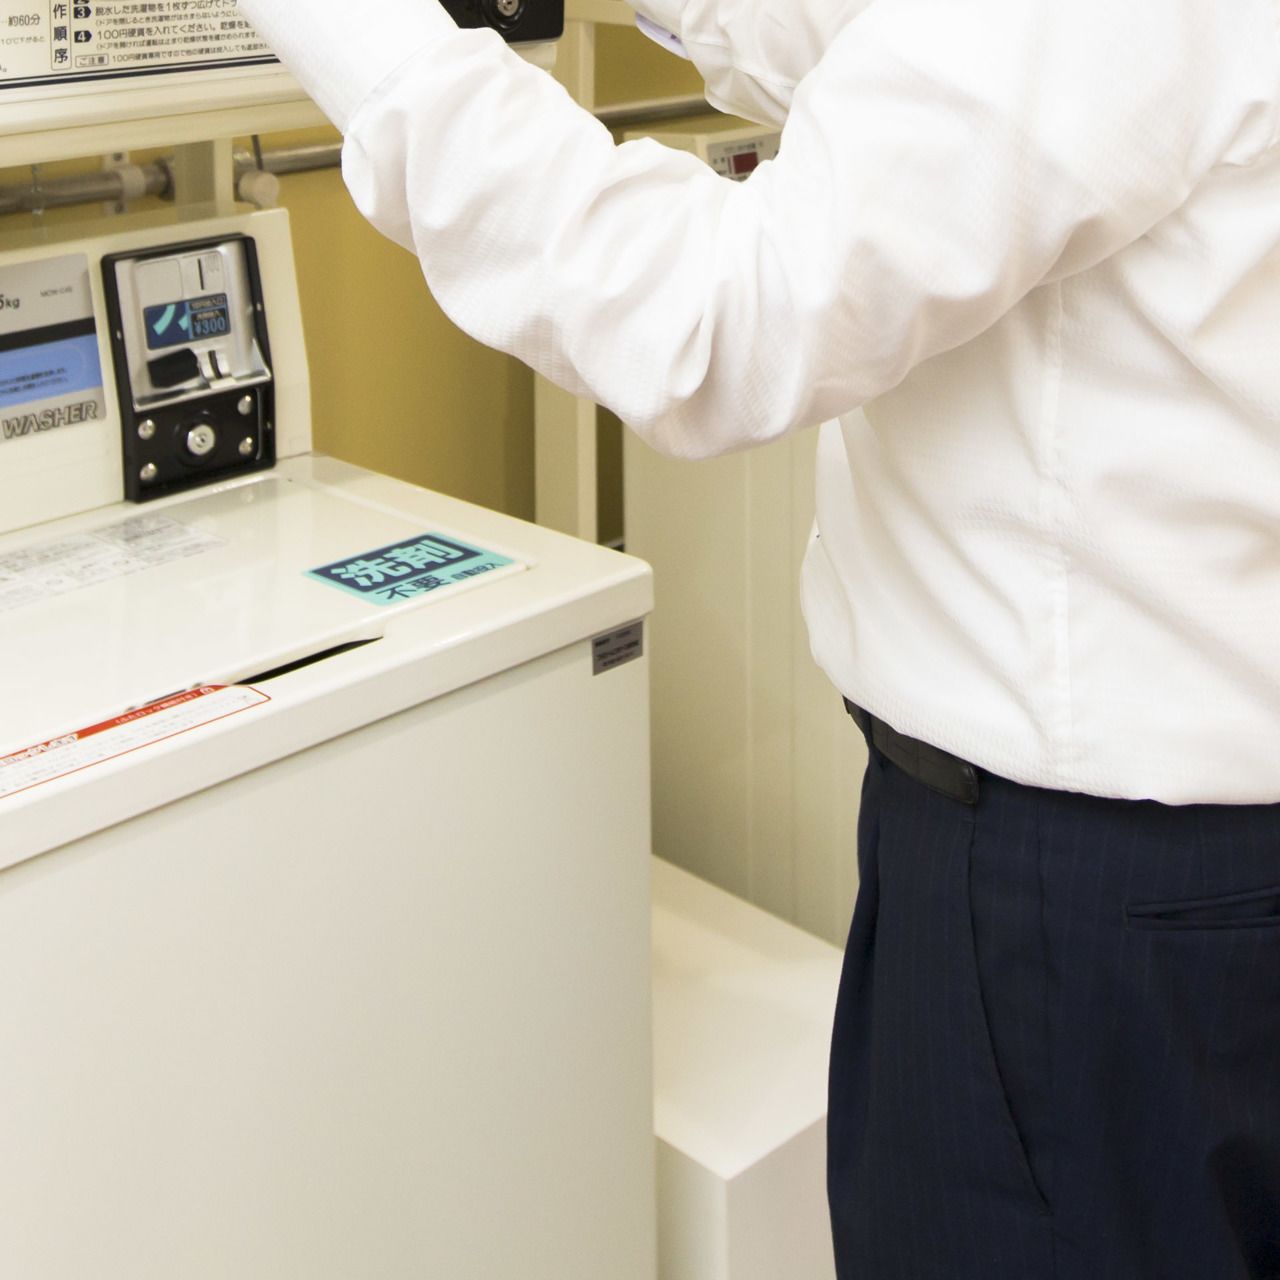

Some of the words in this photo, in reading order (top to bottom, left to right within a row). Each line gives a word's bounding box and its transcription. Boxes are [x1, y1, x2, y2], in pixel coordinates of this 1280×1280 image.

[8, 13, 40, 28] 約60分
[194, 316, 226, 335] ¥300
[2, 399, 98, 439] WASHER
[330, 539, 465, 587] 洗剤
[375, 574, 452, 600] 不要
